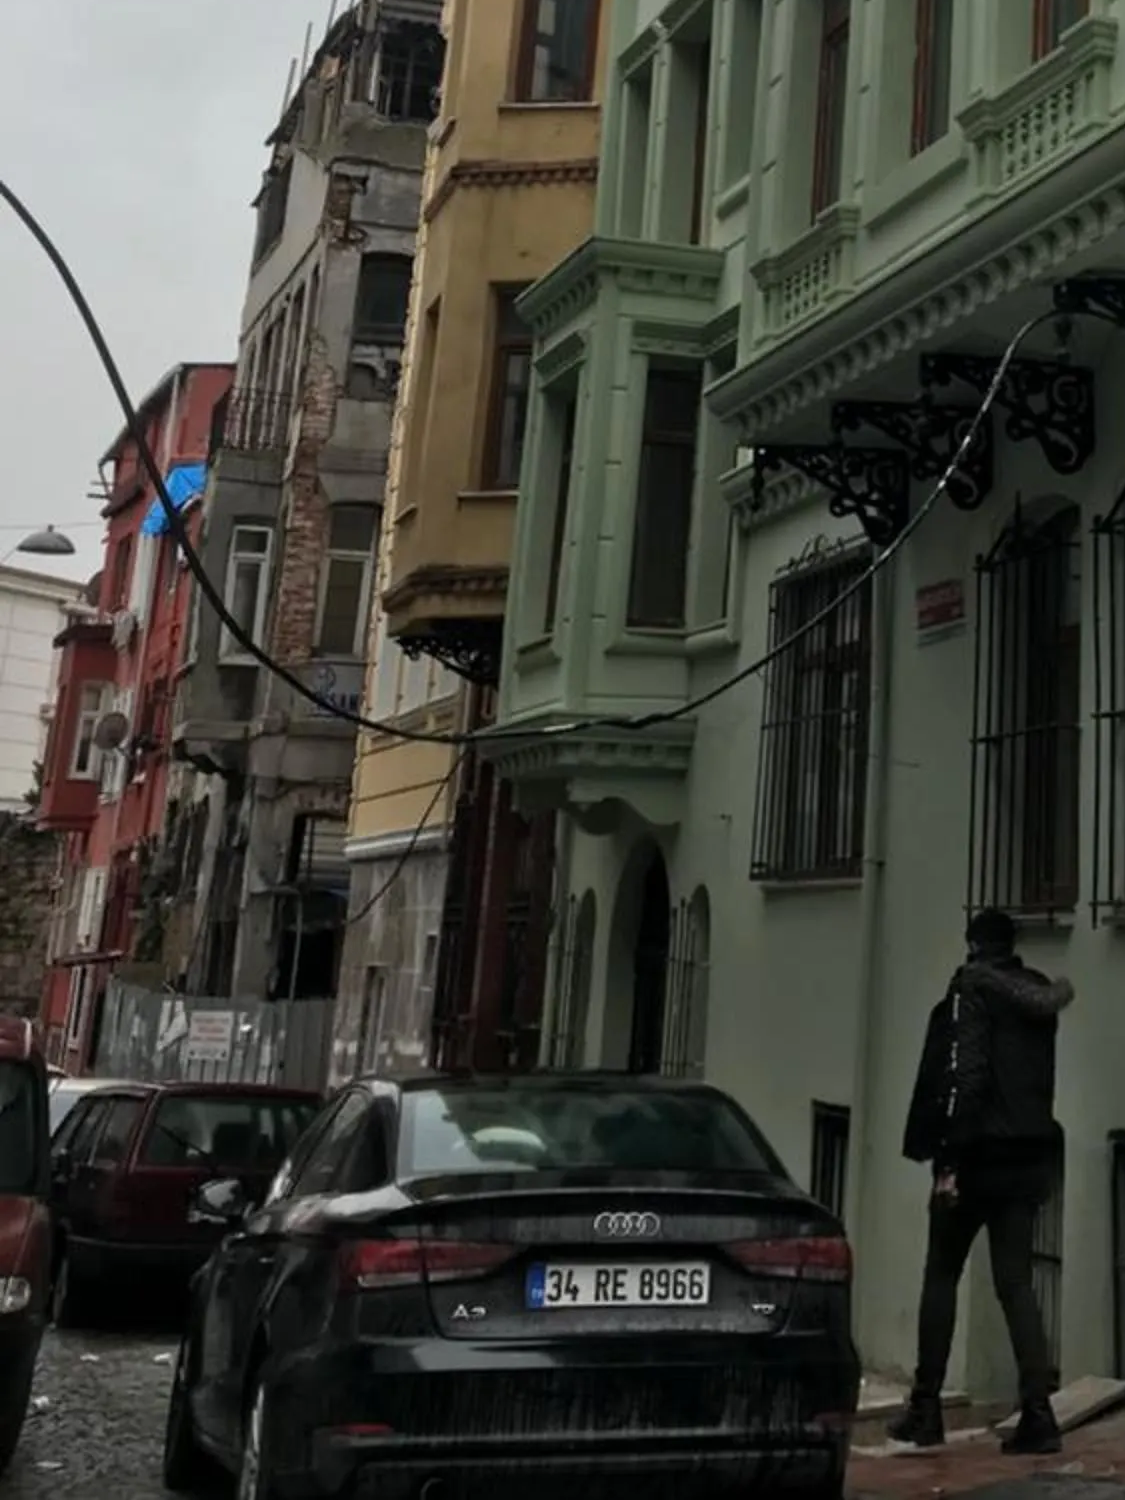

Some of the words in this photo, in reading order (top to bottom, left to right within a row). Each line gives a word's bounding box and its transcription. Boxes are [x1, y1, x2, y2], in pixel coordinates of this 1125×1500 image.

[546, 1268, 580, 1302] 34
[594, 1268, 629, 1302] RE
[639, 1267, 704, 1301] 8966
